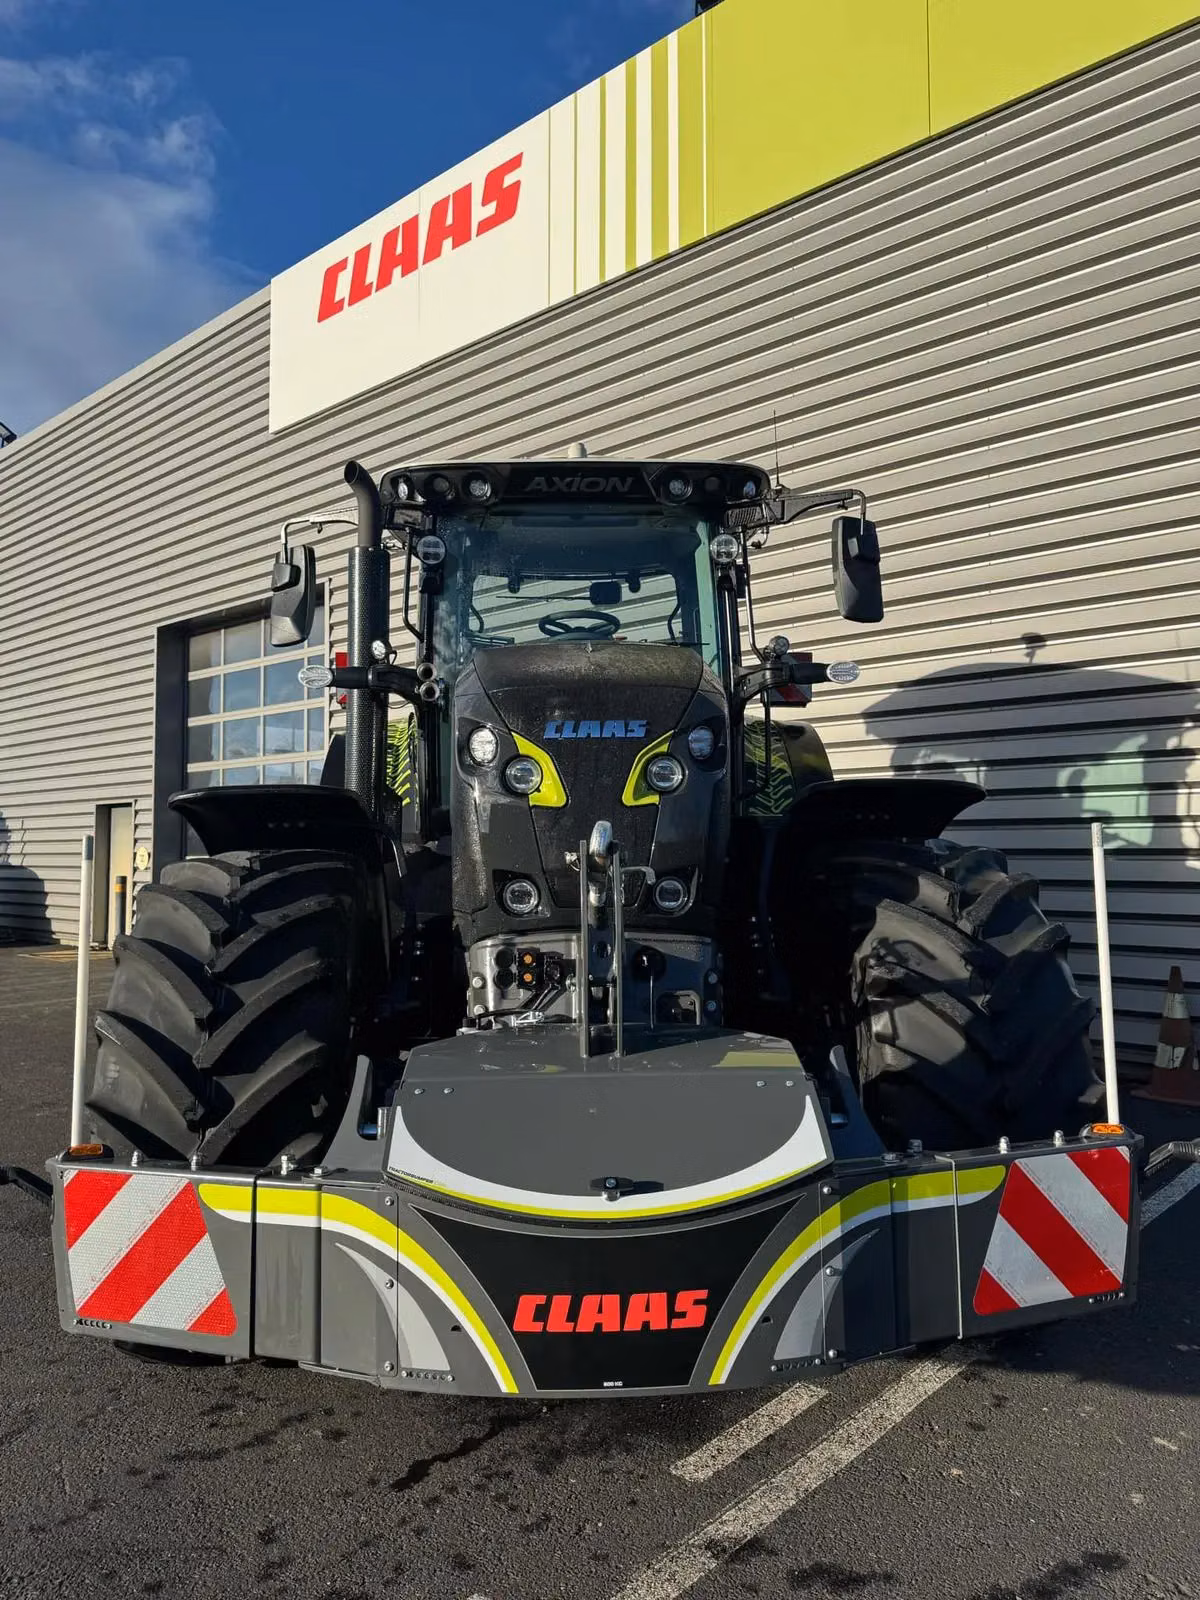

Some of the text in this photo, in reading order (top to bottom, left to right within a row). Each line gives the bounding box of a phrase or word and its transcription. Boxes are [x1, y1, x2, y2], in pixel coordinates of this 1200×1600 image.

[317, 152, 523, 323] CLAAS
[543, 719, 648, 739] CLAAS
[513, 1289, 709, 1332] CLAAS
